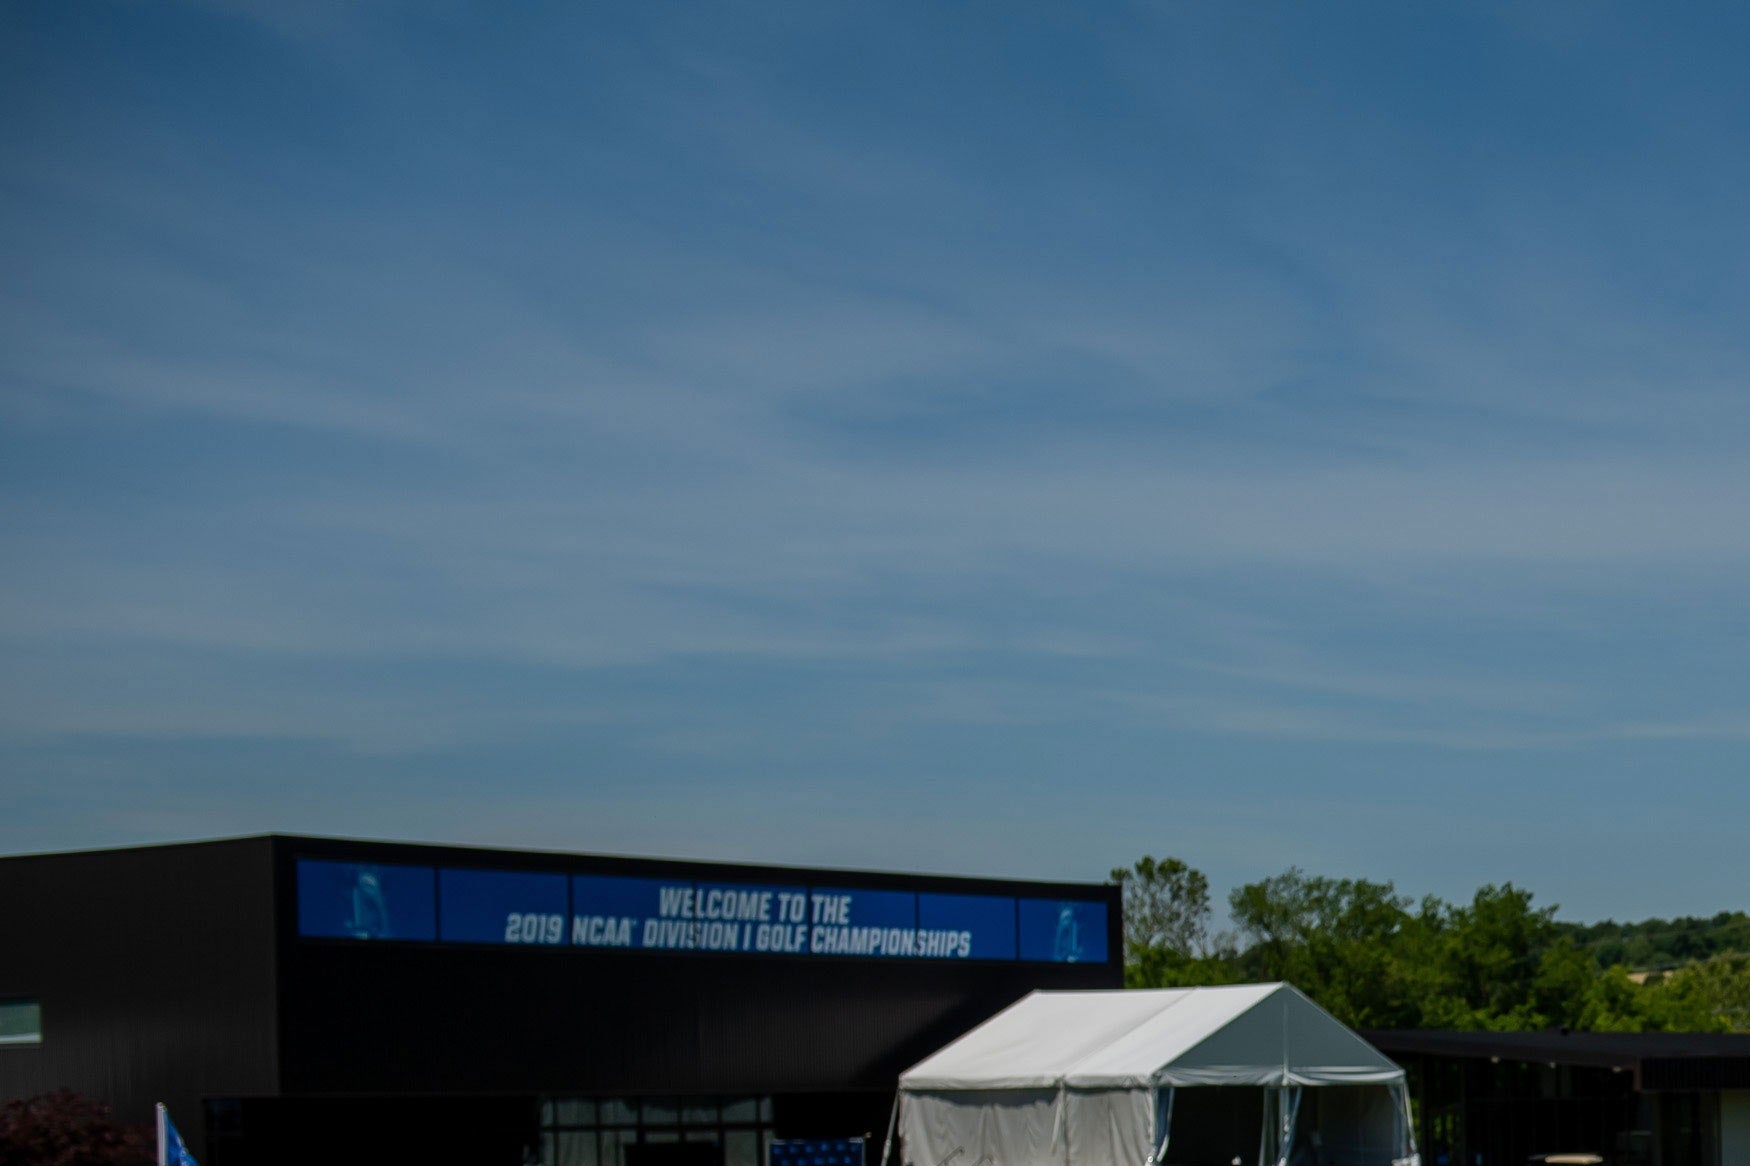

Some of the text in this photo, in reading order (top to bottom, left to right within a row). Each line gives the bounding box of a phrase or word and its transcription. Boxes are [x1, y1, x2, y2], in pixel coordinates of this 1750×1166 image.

[659, 887, 851, 925] WELCOME TO THE
[504, 912, 971, 958] 2019 NCAA DIVISION I GOLF CHAMPIONSHIPS
